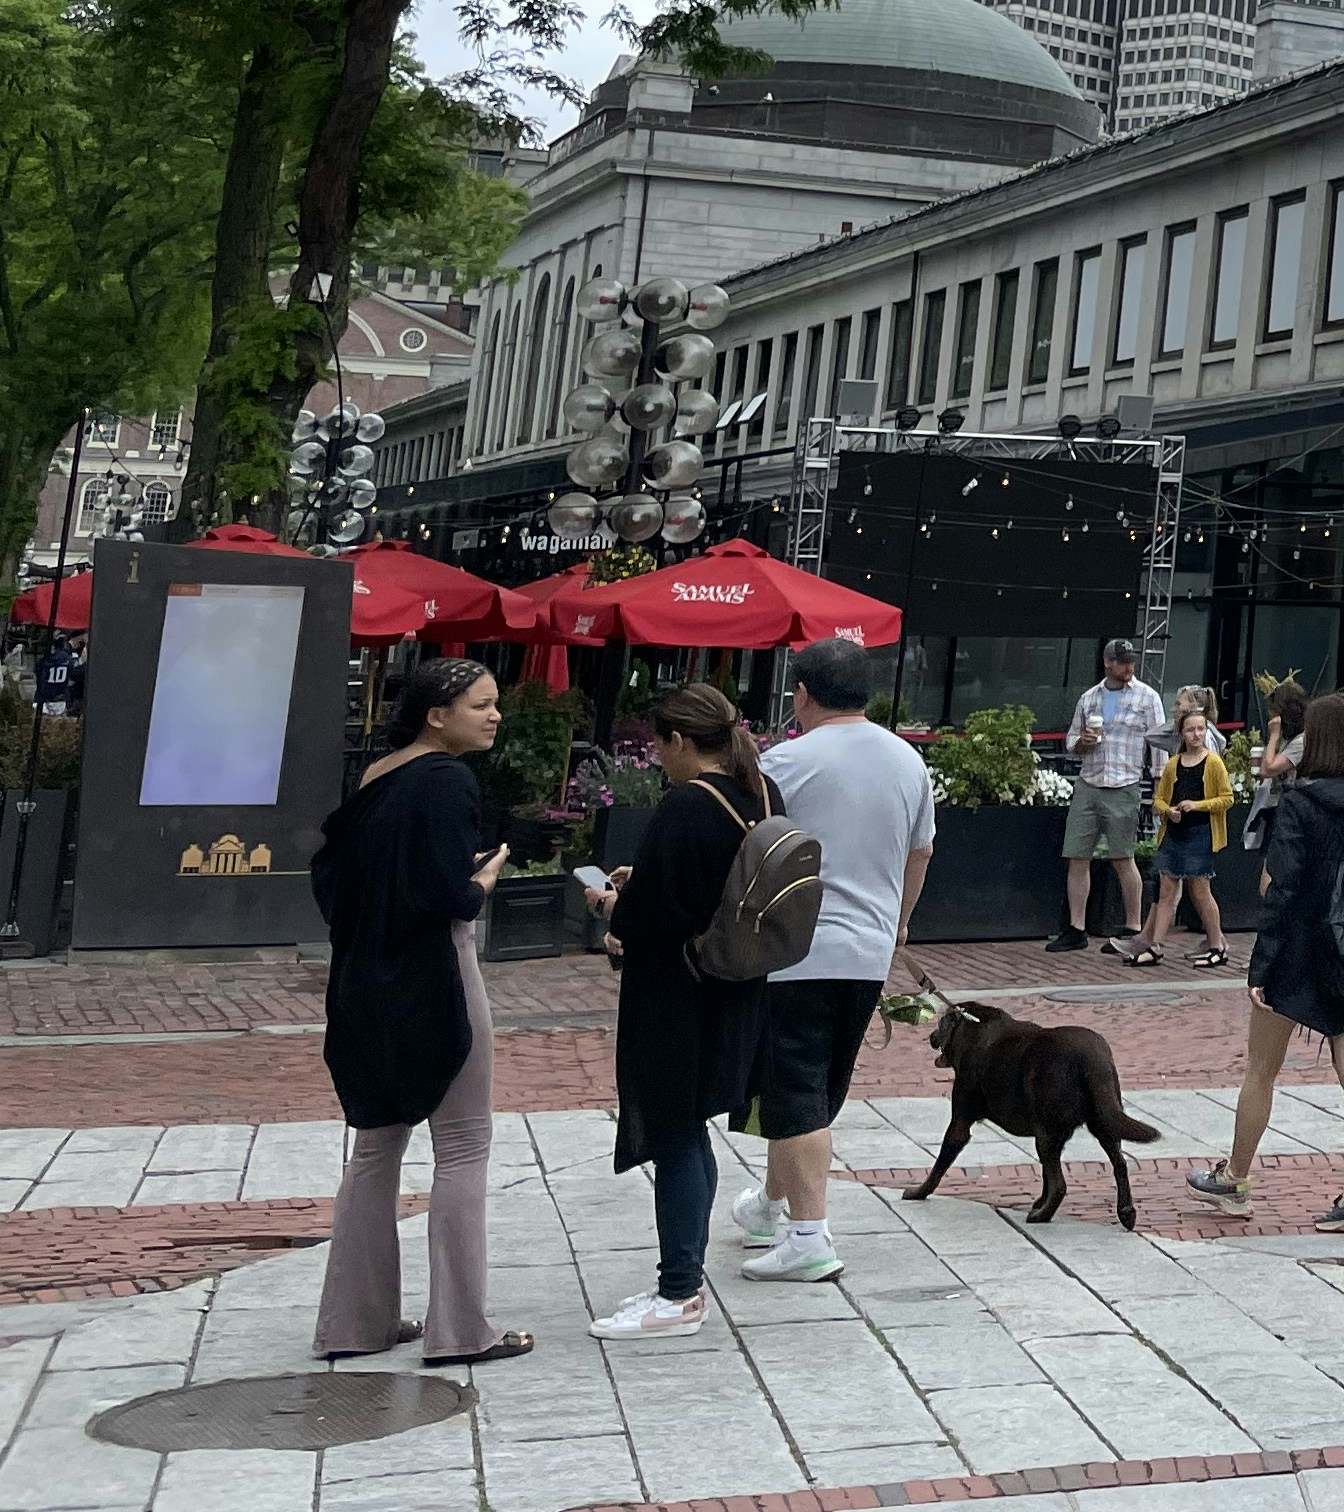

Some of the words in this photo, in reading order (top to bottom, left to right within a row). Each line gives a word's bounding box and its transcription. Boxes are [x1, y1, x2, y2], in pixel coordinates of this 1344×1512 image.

[671, 582, 755, 595] SAMUEL
[673, 591, 745, 605] ADAMS
[47, 666, 68, 683] 10
